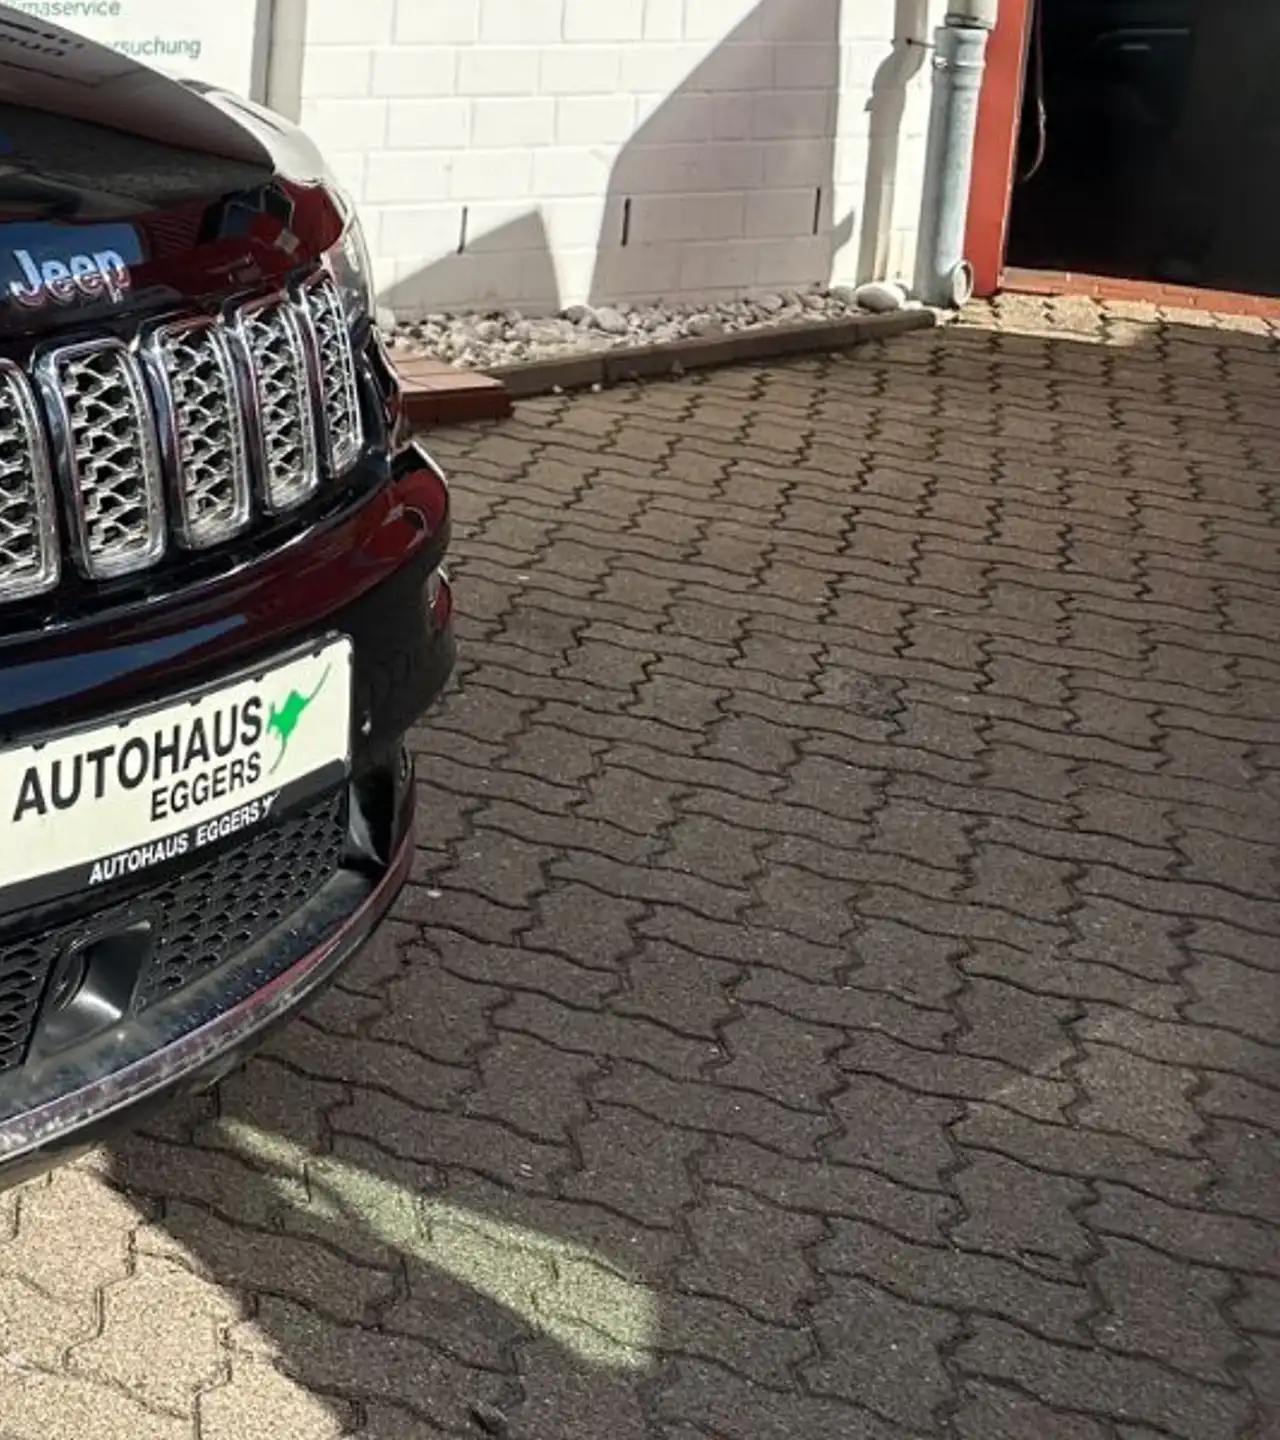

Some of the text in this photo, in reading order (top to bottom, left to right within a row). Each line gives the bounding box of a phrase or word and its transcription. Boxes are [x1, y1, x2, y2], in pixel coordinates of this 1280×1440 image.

[6, 248, 132, 307] Jeep
[12, 695, 264, 823] AUTOHAUS
[149, 750, 262, 822] EGGERS
[88, 805, 260, 885] AUTOHAUS EGGERS
